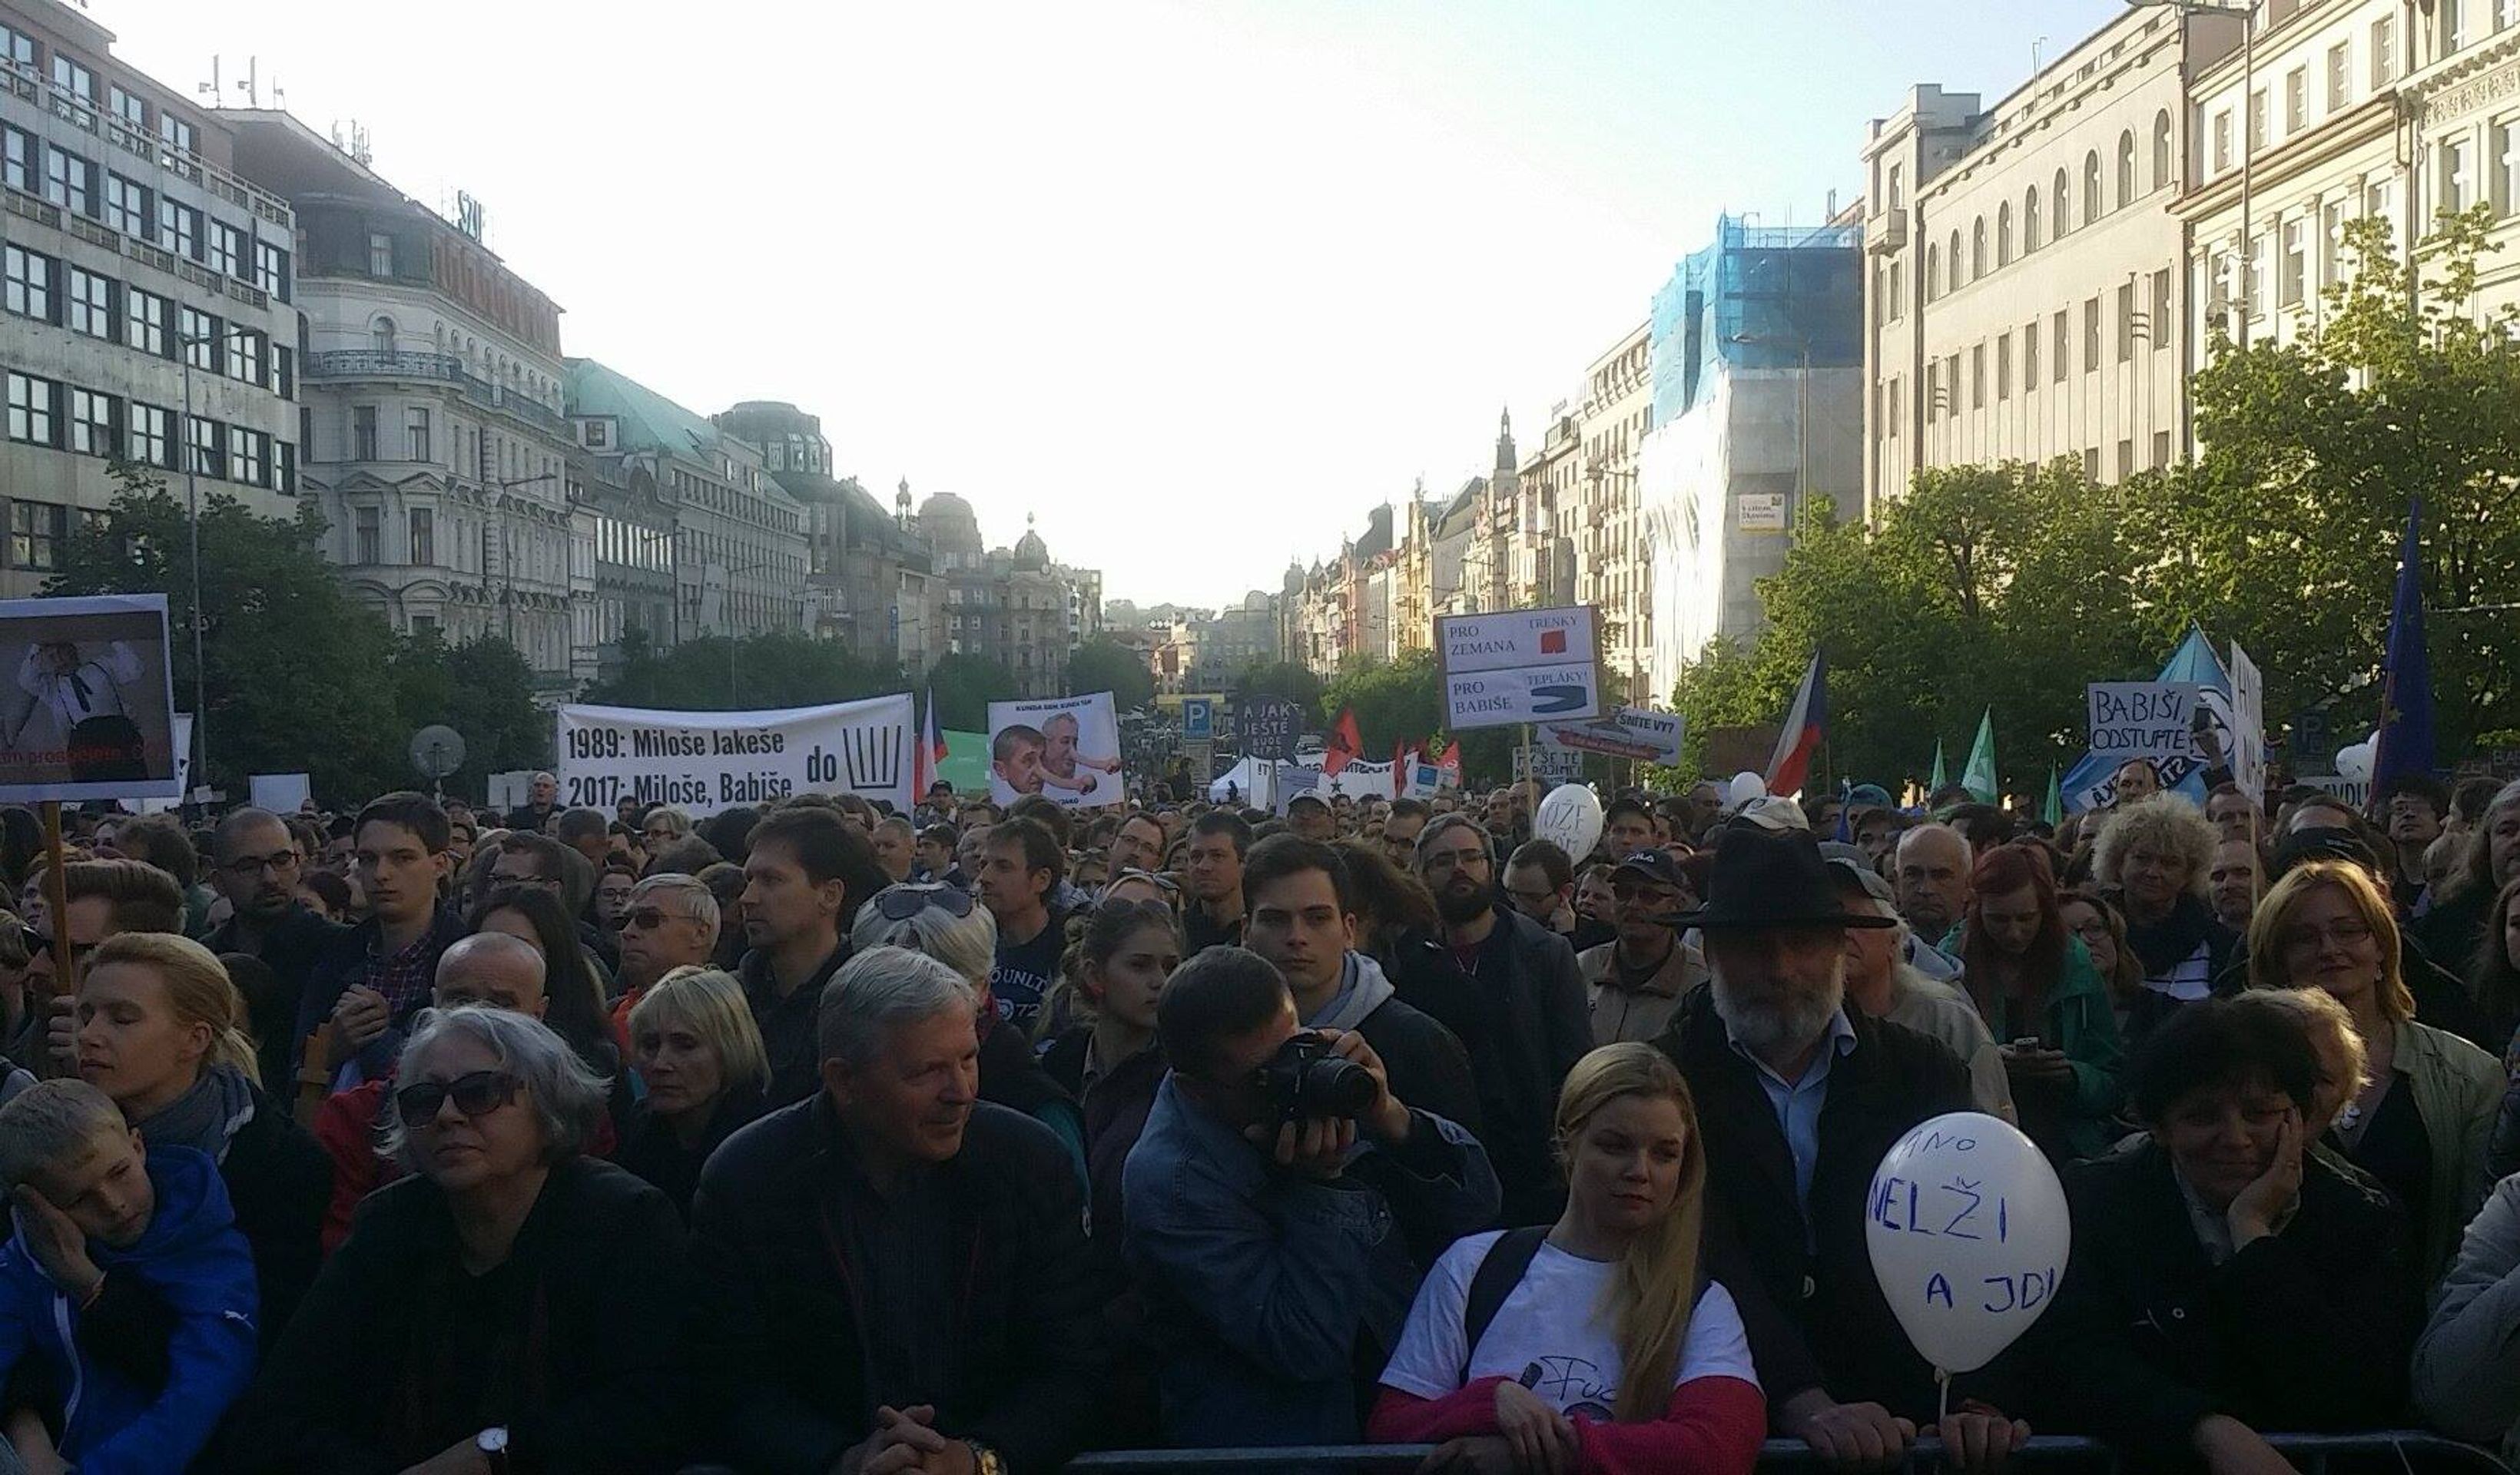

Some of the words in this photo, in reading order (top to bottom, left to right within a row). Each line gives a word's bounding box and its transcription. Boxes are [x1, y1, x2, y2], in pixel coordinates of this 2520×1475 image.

[1450, 625, 1479, 638] PRO
[1451, 640, 1516, 656] ZEMANA
[1453, 681, 1485, 695] PRO
[1189, 704, 1205, 728] P
[1244, 704, 1253, 718] A
[1259, 703, 1290, 718] JAK
[1454, 695, 1513, 714] BABIŠE
[2095, 688, 2186, 724] BABIŠI,
[567, 728, 626, 759] 1989:
[633, 728, 706, 758] Miloše
[711, 728, 784, 756] Jakeše
[807, 745, 837, 783] do
[568, 777, 626, 807] 2017:
[634, 774, 712, 808] Miloše,
[721, 772, 793, 803] Babiše
[1895, 1129, 1977, 1167] ANO
[1867, 1175, 2007, 1245] NELŽI
[1926, 1272, 1953, 1310] A
